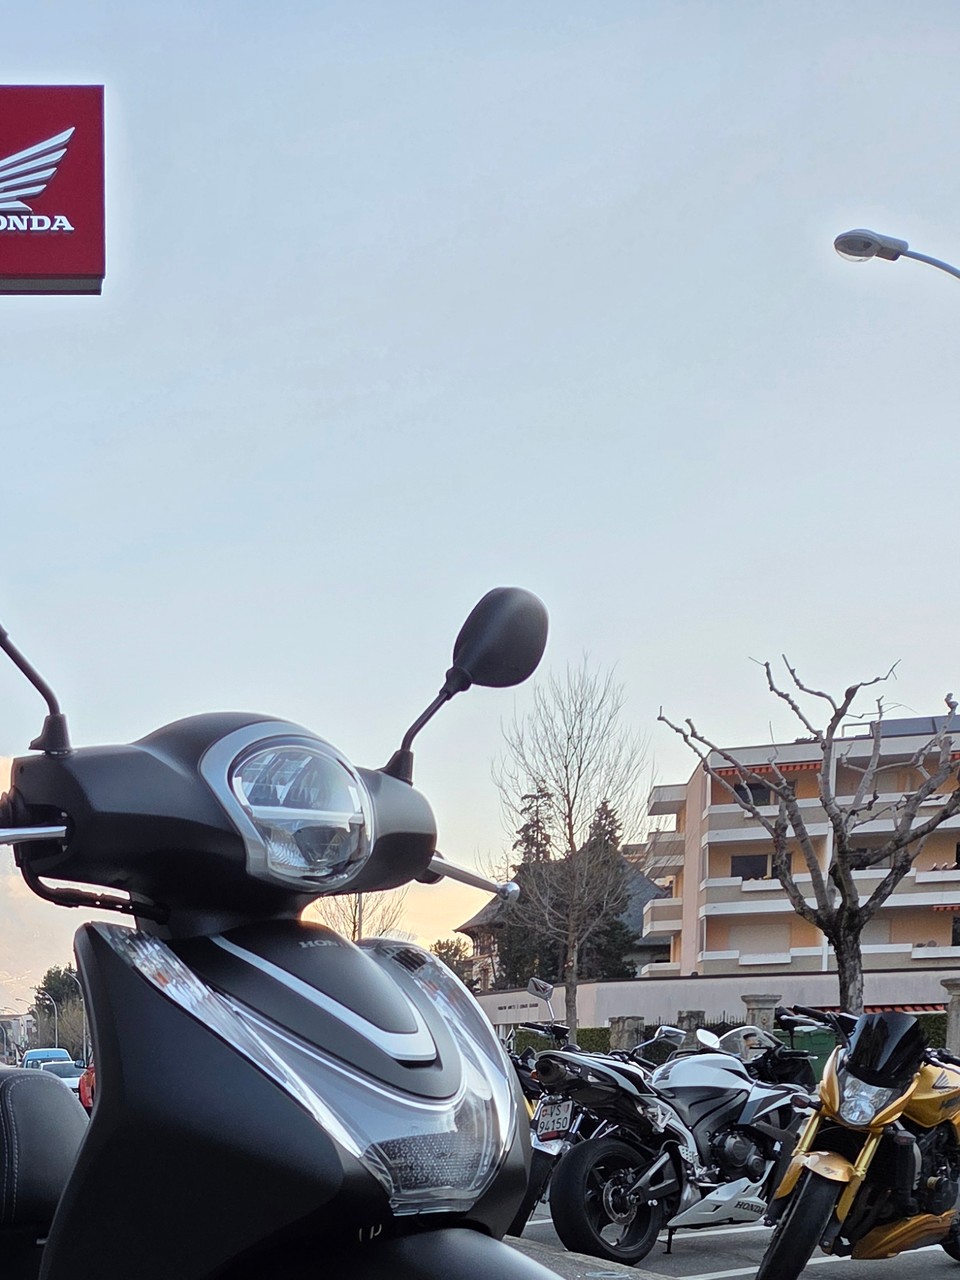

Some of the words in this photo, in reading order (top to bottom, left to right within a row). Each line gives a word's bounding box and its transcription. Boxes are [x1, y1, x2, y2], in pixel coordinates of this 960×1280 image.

[550, 1105, 561, 1117] VS
[539, 1117, 567, 1133] 94150
[734, 1201, 765, 1215] HONDA
